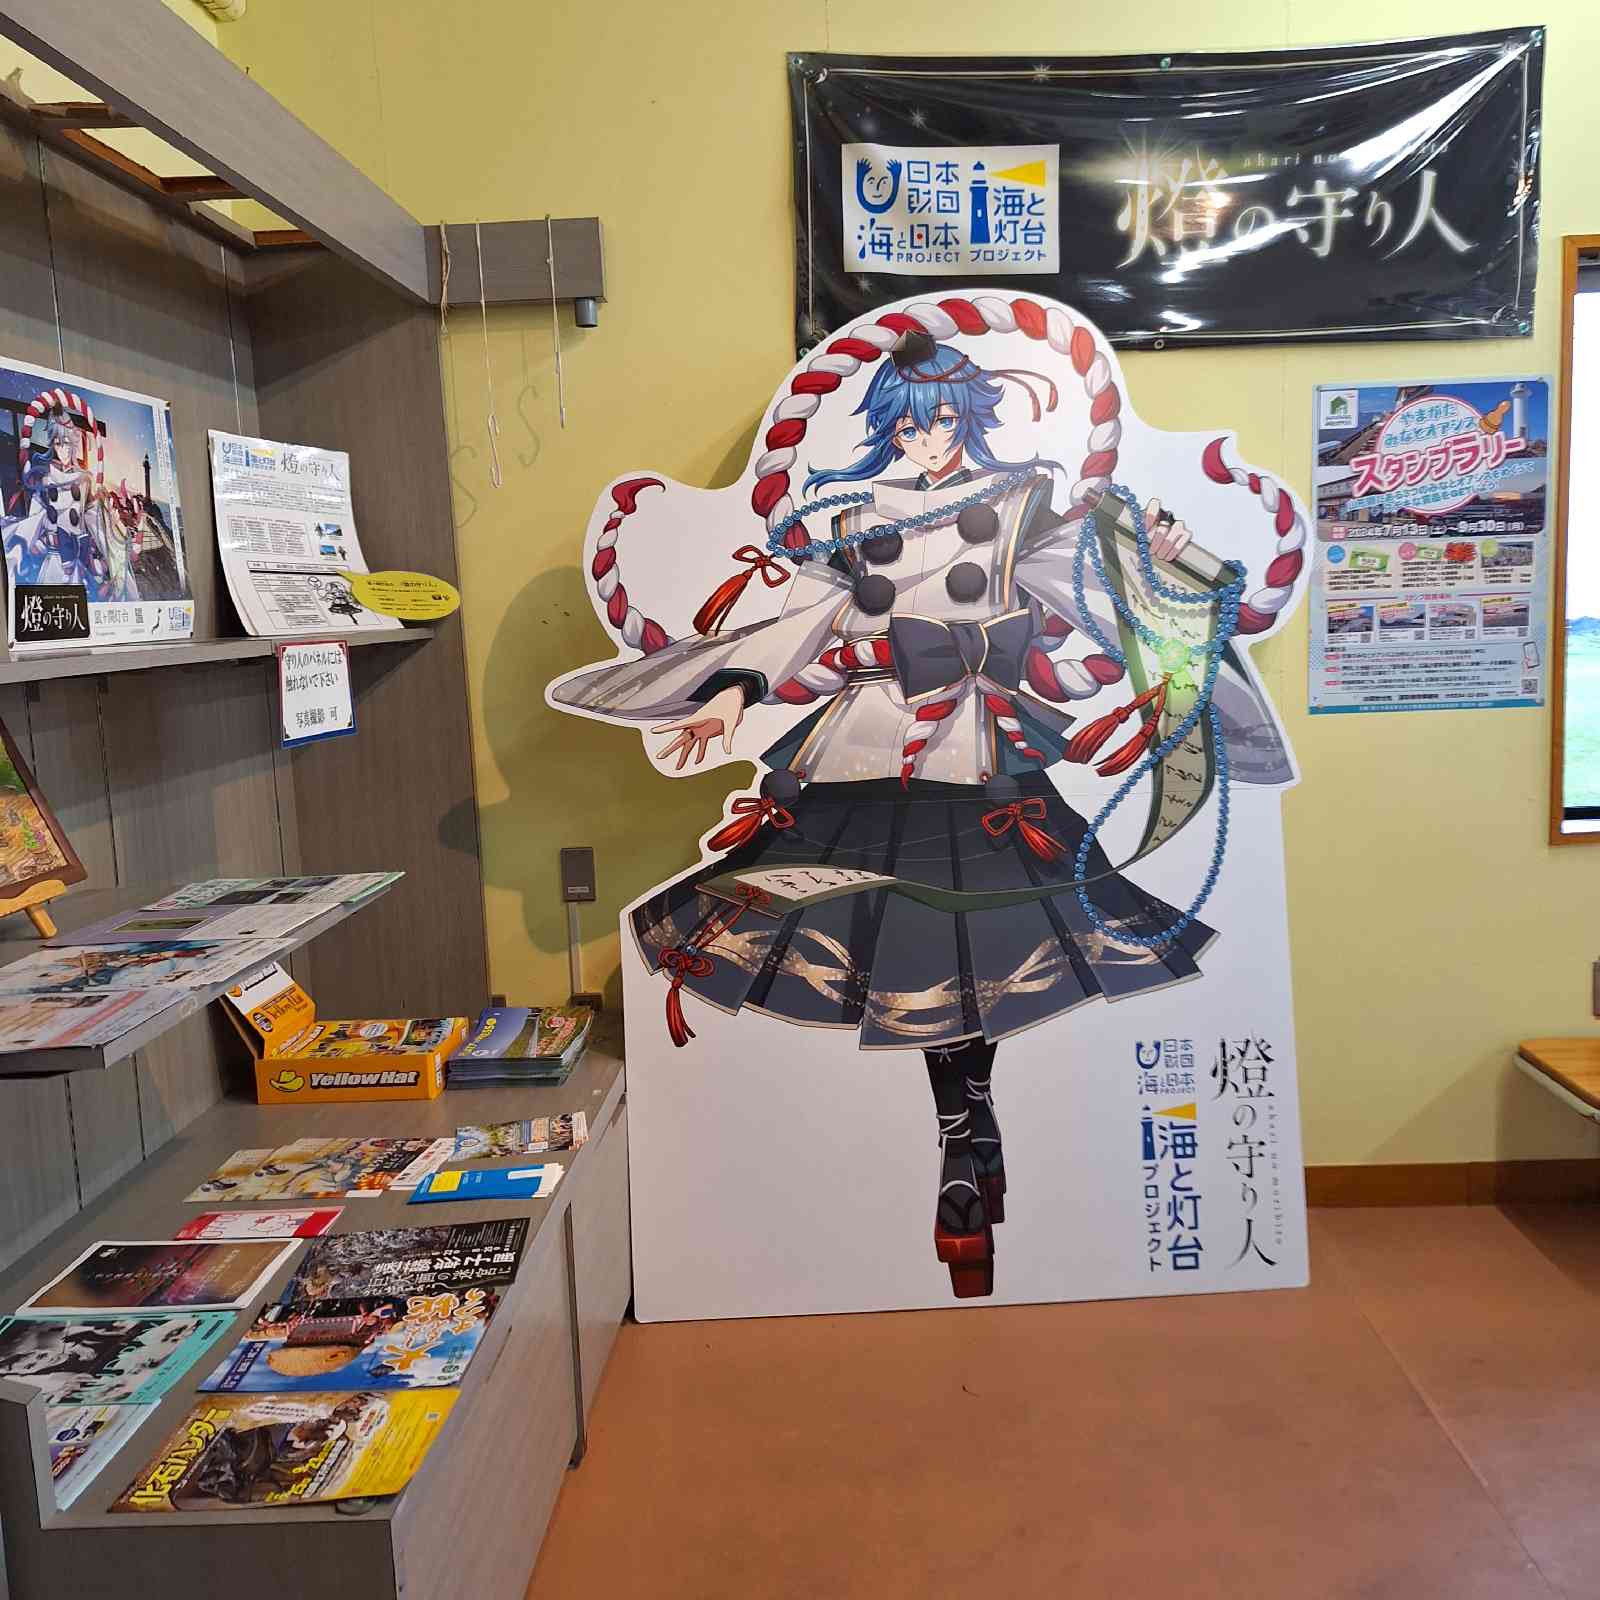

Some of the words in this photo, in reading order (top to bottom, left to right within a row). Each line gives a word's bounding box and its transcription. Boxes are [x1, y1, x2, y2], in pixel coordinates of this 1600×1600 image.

[907, 160, 960, 185] 日本
[908, 188, 960, 214] 財団
[993, 185, 1046, 217] 海と
[1116, 152, 1480, 269] 燈の守り人
[857, 218, 960, 262] 海と日本
[994, 219, 1047, 245] 灯台
[897, 252, 960, 264] PROJECT
[969, 249, 1047, 262] プロジェクト
[1402, 403, 1458, 423] やまがた
[1384, 415, 1477, 448] みなとオアシス
[1352, 432, 1527, 498] スタンプラリー
[20, 594, 87, 633] 燈の守り人
[310, 1070, 419, 1088] YellowHat
[1211, 1030, 1278, 1271] 燈の守り人
[1158, 1121, 1203, 1271] 海と灯台
[1143, 1163, 1162, 1272] プロジェクト
